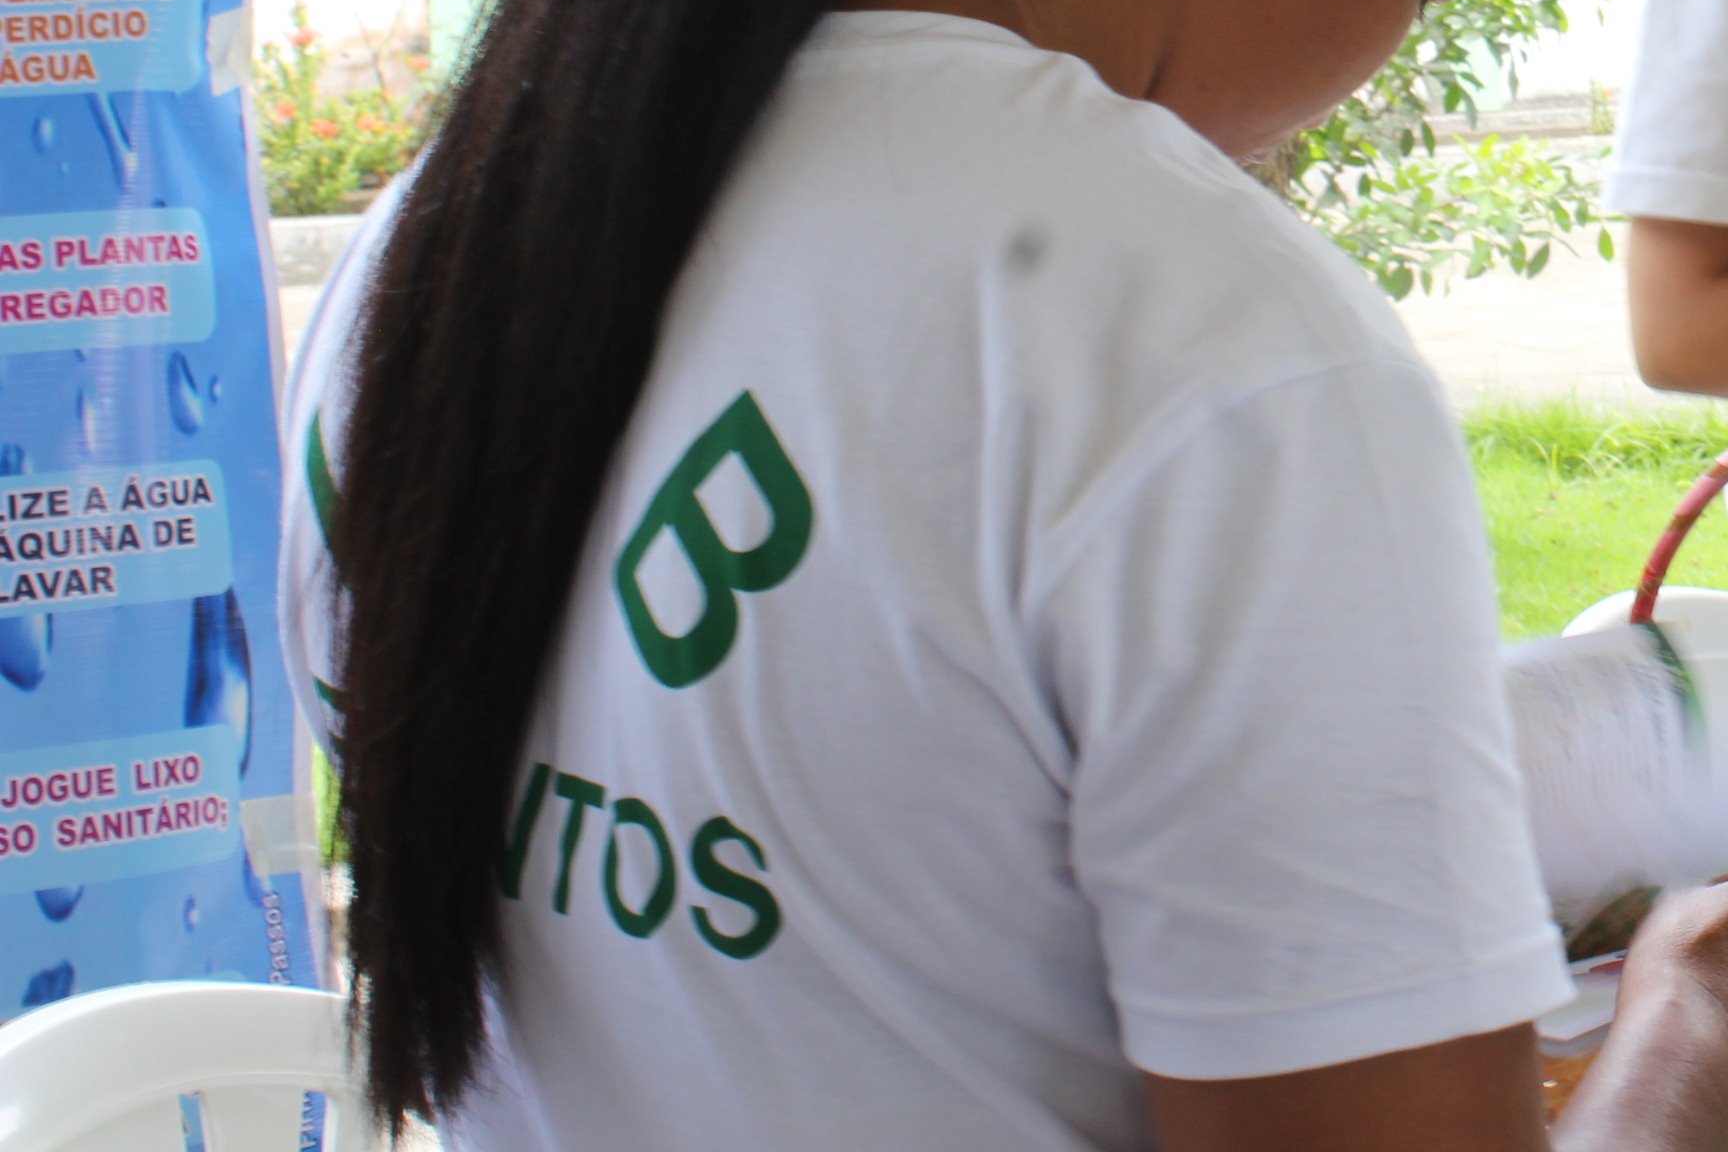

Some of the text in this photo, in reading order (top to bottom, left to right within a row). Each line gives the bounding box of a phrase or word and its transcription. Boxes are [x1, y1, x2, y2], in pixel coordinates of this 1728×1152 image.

[0, 6, 148, 43] ERDÍCIO
[0, 50, 97, 85] ÁGUA
[0, 234, 200, 272] AS PLANTAS
[0, 286, 169, 323] REGADOR
[0, 477, 212, 521] IZE A ÁGUA
[154, 518, 196, 548] DE
[1, 755, 201, 808] JOGUE LIXO
[57, 796, 229, 848] SANITÁRIO;
